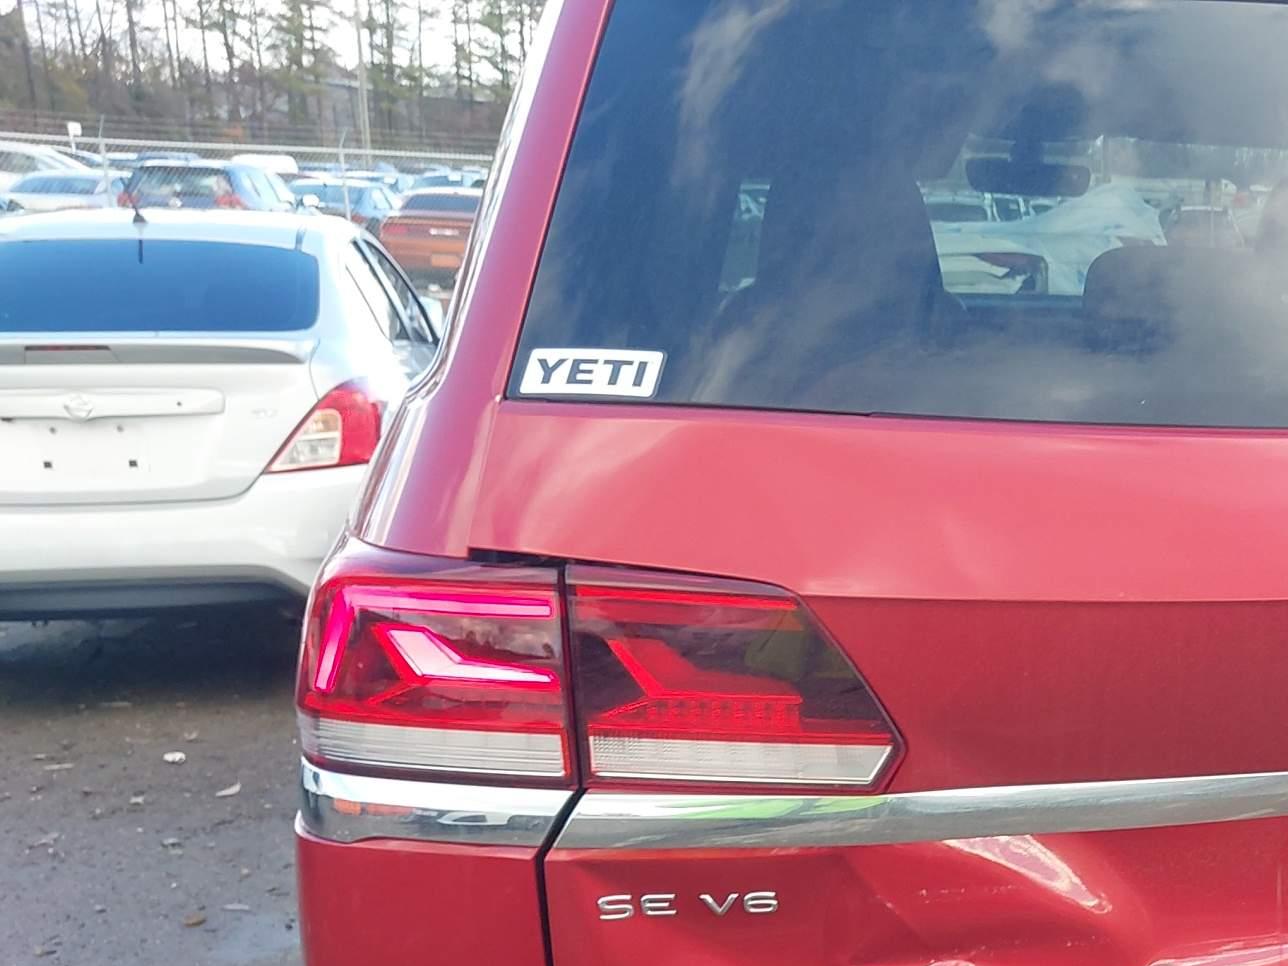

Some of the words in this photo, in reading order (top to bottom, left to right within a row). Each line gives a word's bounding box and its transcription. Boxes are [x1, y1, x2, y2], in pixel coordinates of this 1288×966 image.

[536, 358, 650, 388] YETI
[597, 893, 677, 920] SE
[699, 891, 778, 917] V6
